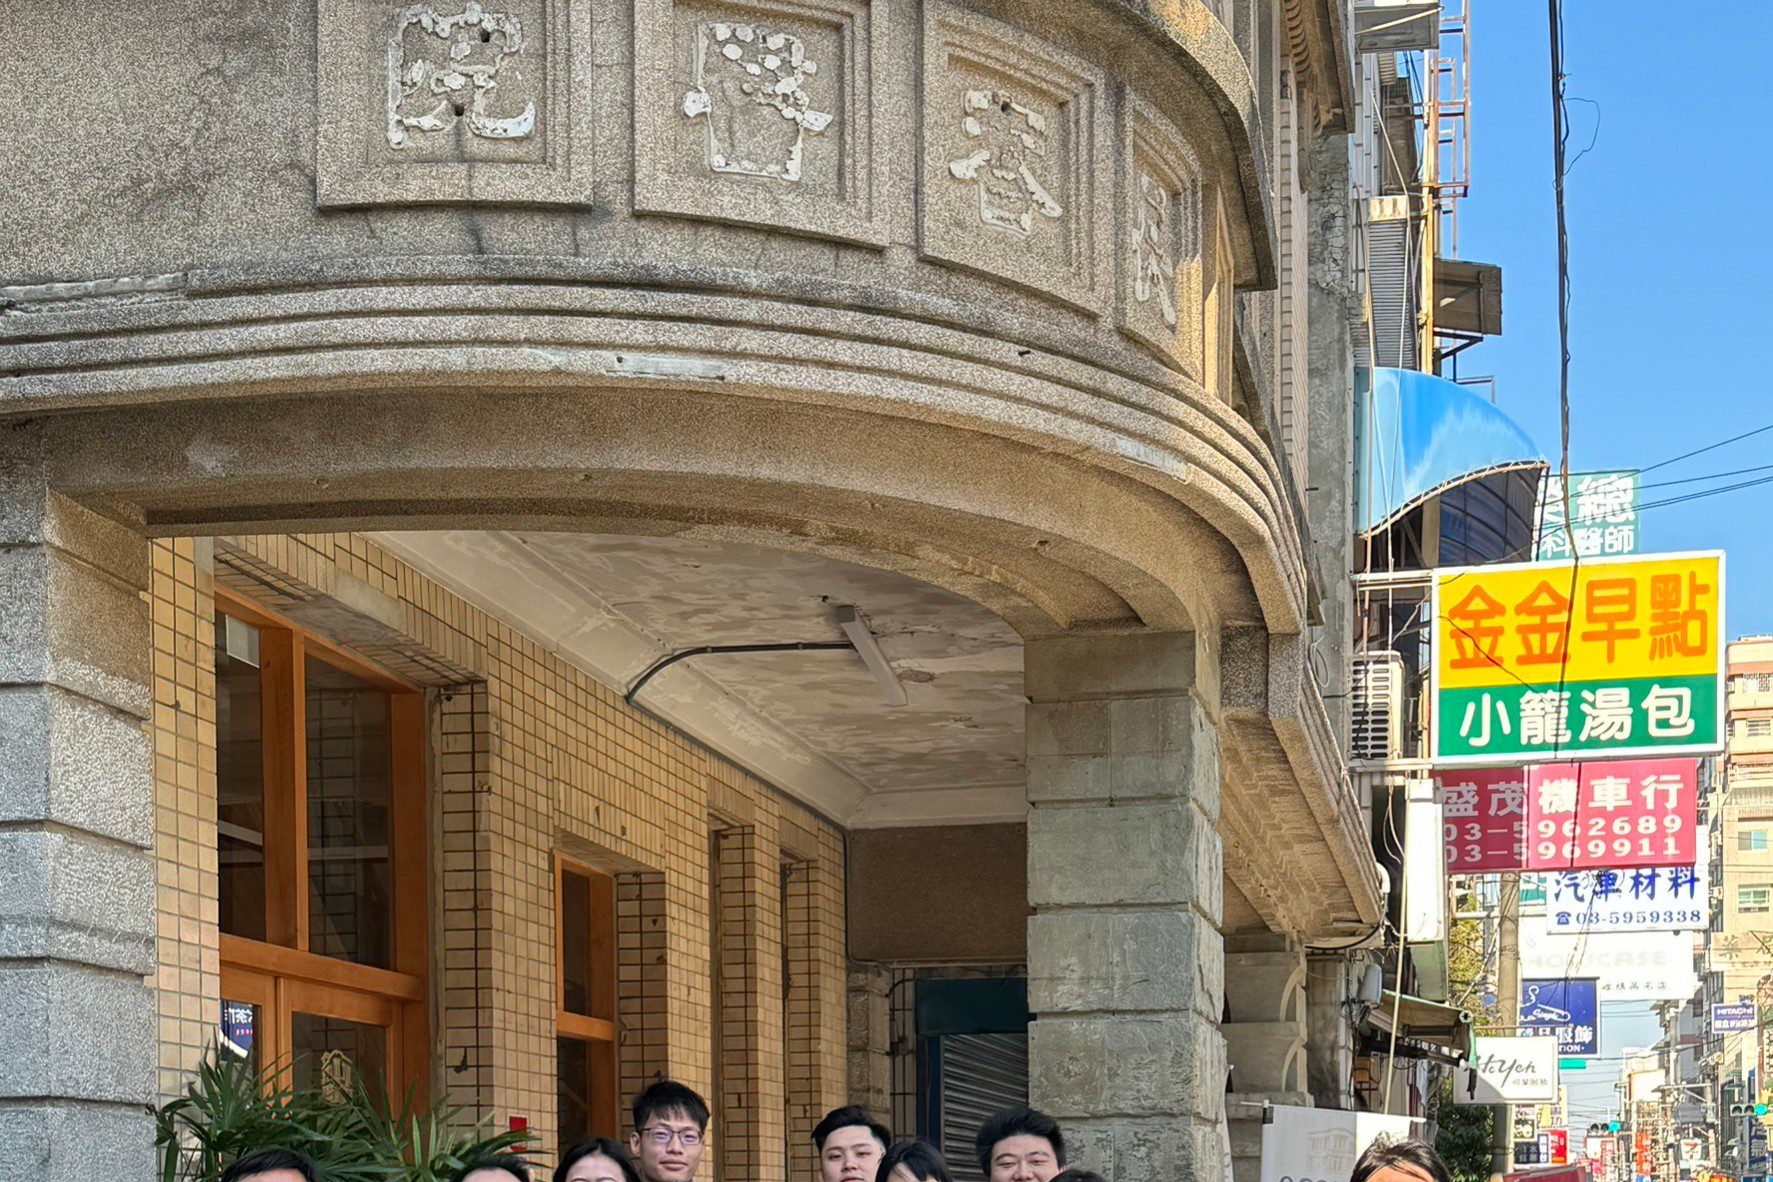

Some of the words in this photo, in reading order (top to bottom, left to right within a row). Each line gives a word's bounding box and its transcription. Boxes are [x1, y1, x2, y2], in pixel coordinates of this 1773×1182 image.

[1448, 571, 1710, 670] 金金早點
[1459, 683, 1695, 747] 小籠湯包
[1442, 774, 1684, 818] 盛茂機車行
[1554, 867, 1701, 903] 汽車材料
